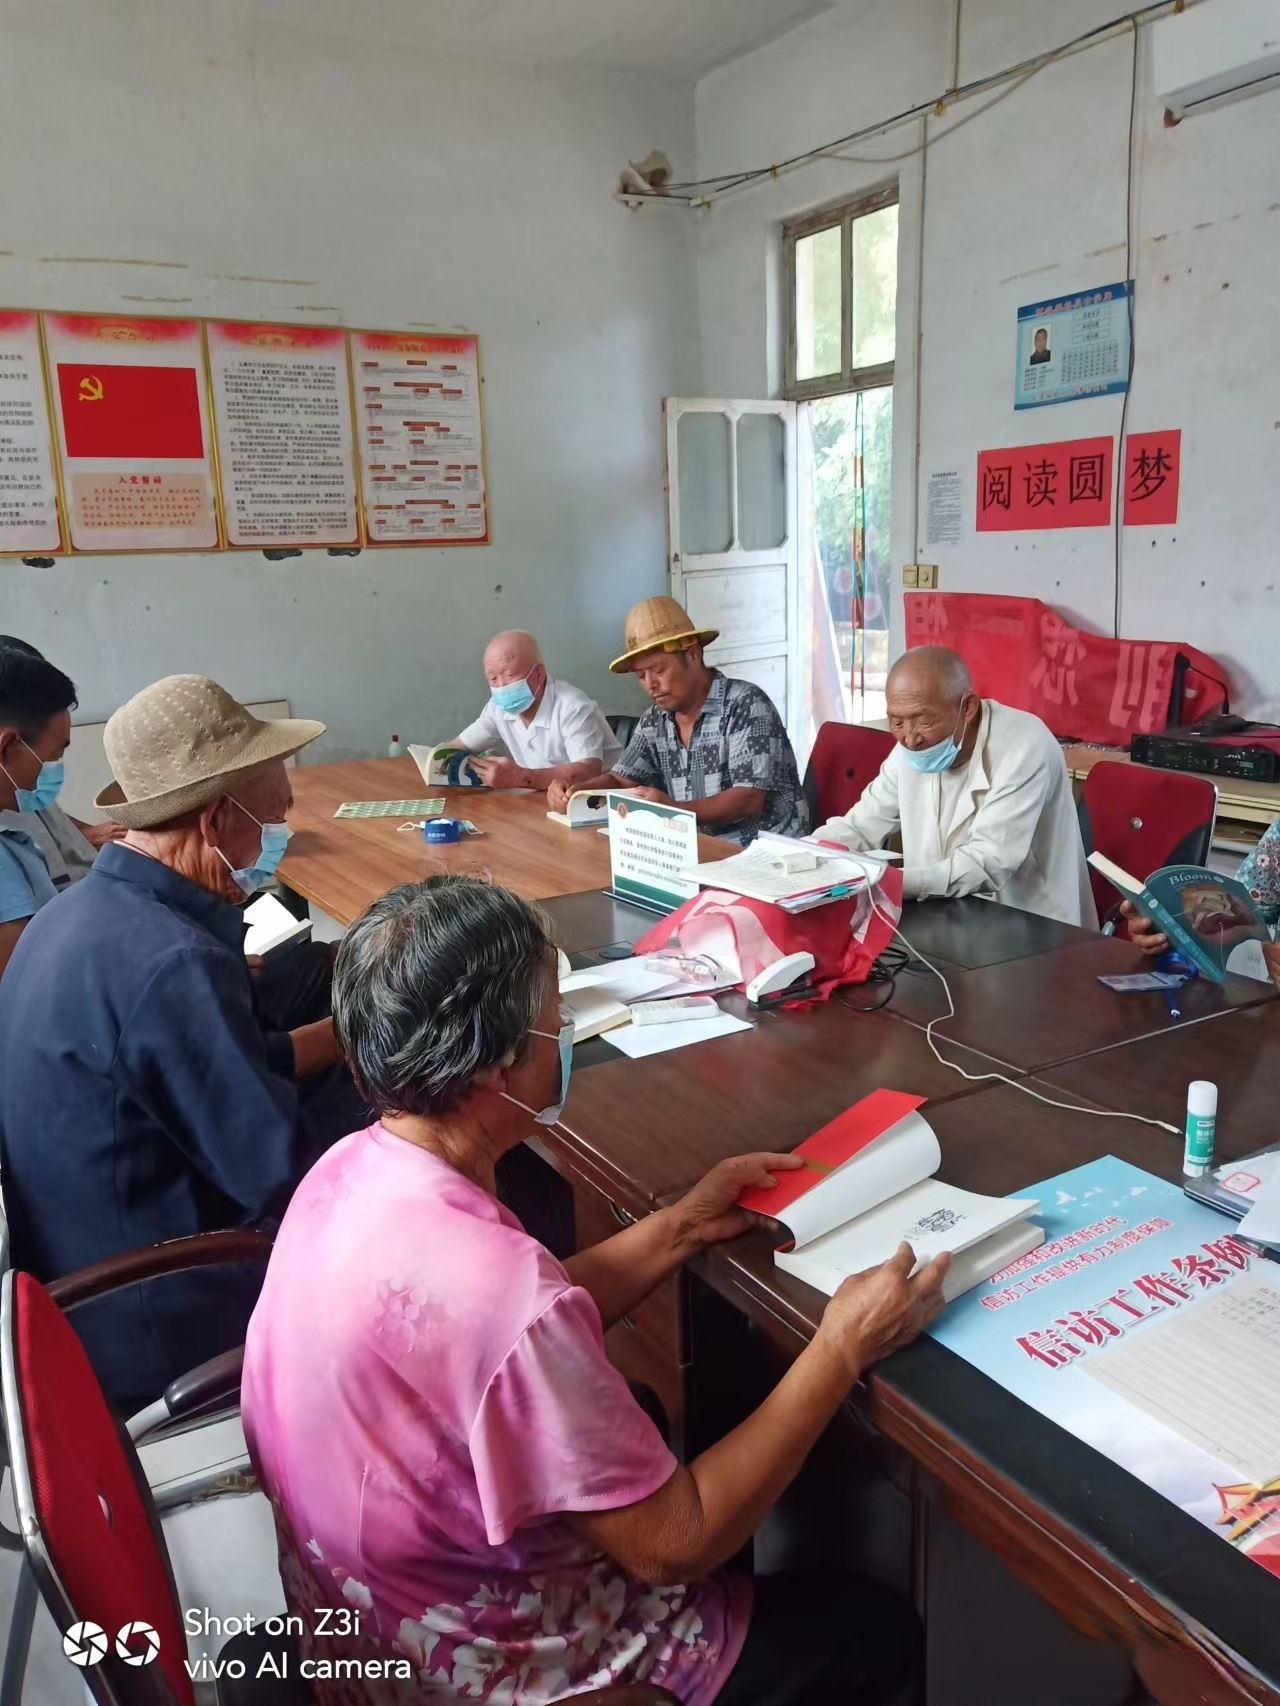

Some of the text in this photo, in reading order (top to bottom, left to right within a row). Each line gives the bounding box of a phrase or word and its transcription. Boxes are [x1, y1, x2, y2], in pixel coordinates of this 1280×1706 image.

[982, 447, 1173, 511] 阅读圆梦
[1169, 873, 1212, 886] Bloom
[980, 1216, 1173, 1310] 信访工作提供有力制度保障
[1014, 1234, 1267, 1369] 信访工作条例
